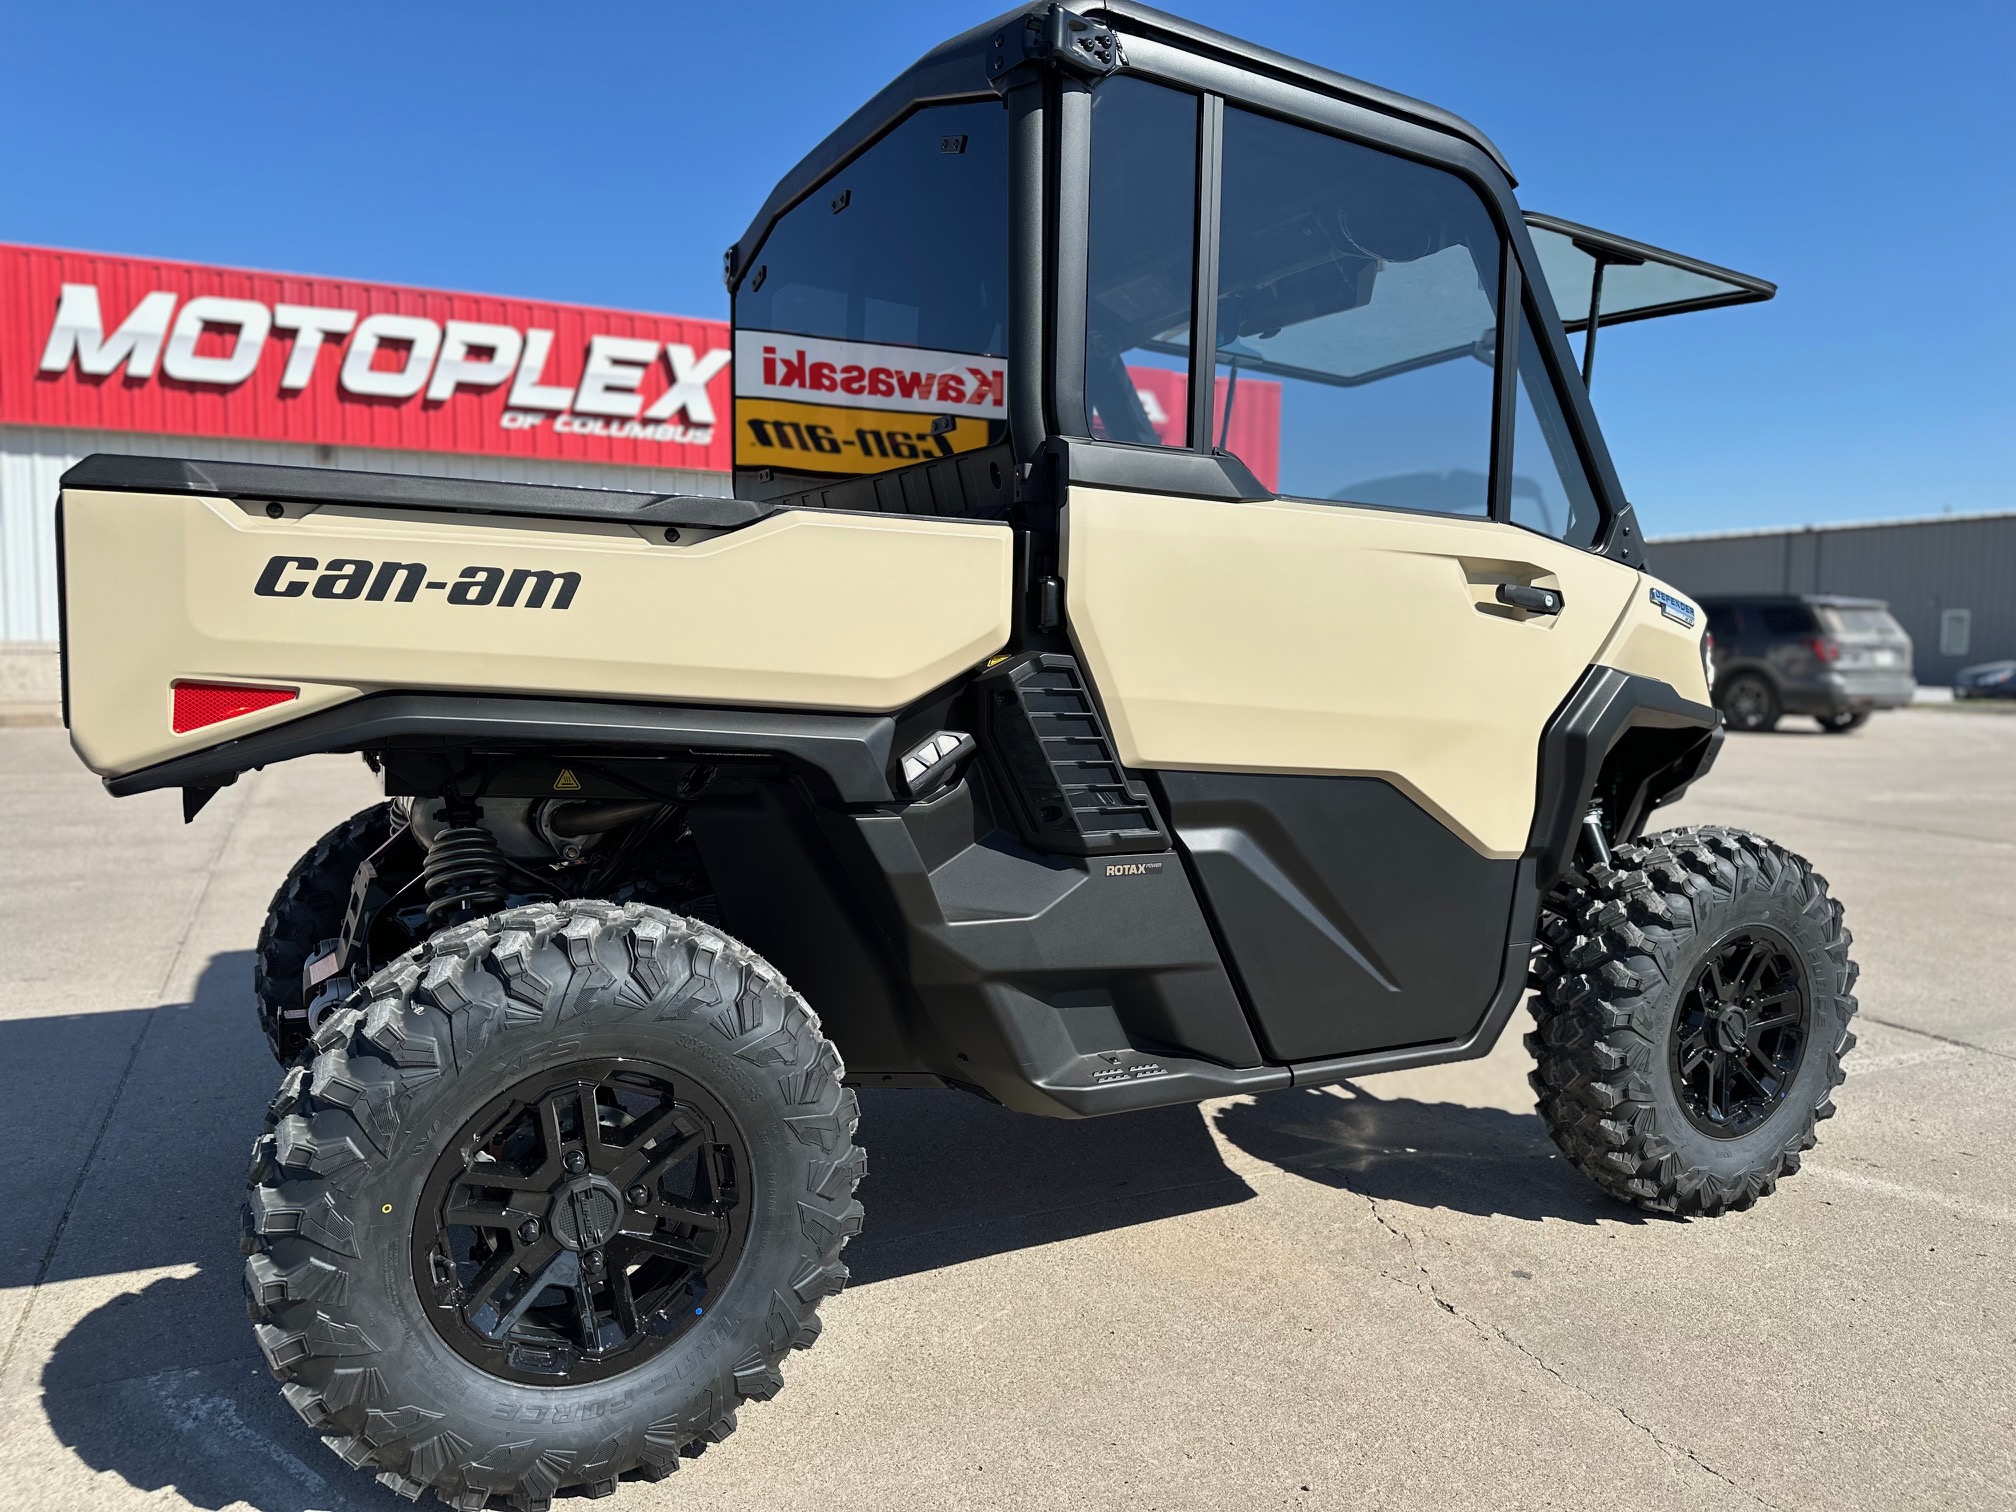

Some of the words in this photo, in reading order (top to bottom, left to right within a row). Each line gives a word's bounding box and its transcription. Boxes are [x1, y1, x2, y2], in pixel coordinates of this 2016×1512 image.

[40, 284, 732, 425] MOTOPLEX
[500, 410, 545, 430] OF
[553, 415, 714, 446] COLUMBUS
[254, 555, 582, 610] can-am
[1654, 589, 1694, 616] DEFENDER
[1106, 863, 1146, 876] ROTAX
[491, 1390, 634, 1425] FORCE
